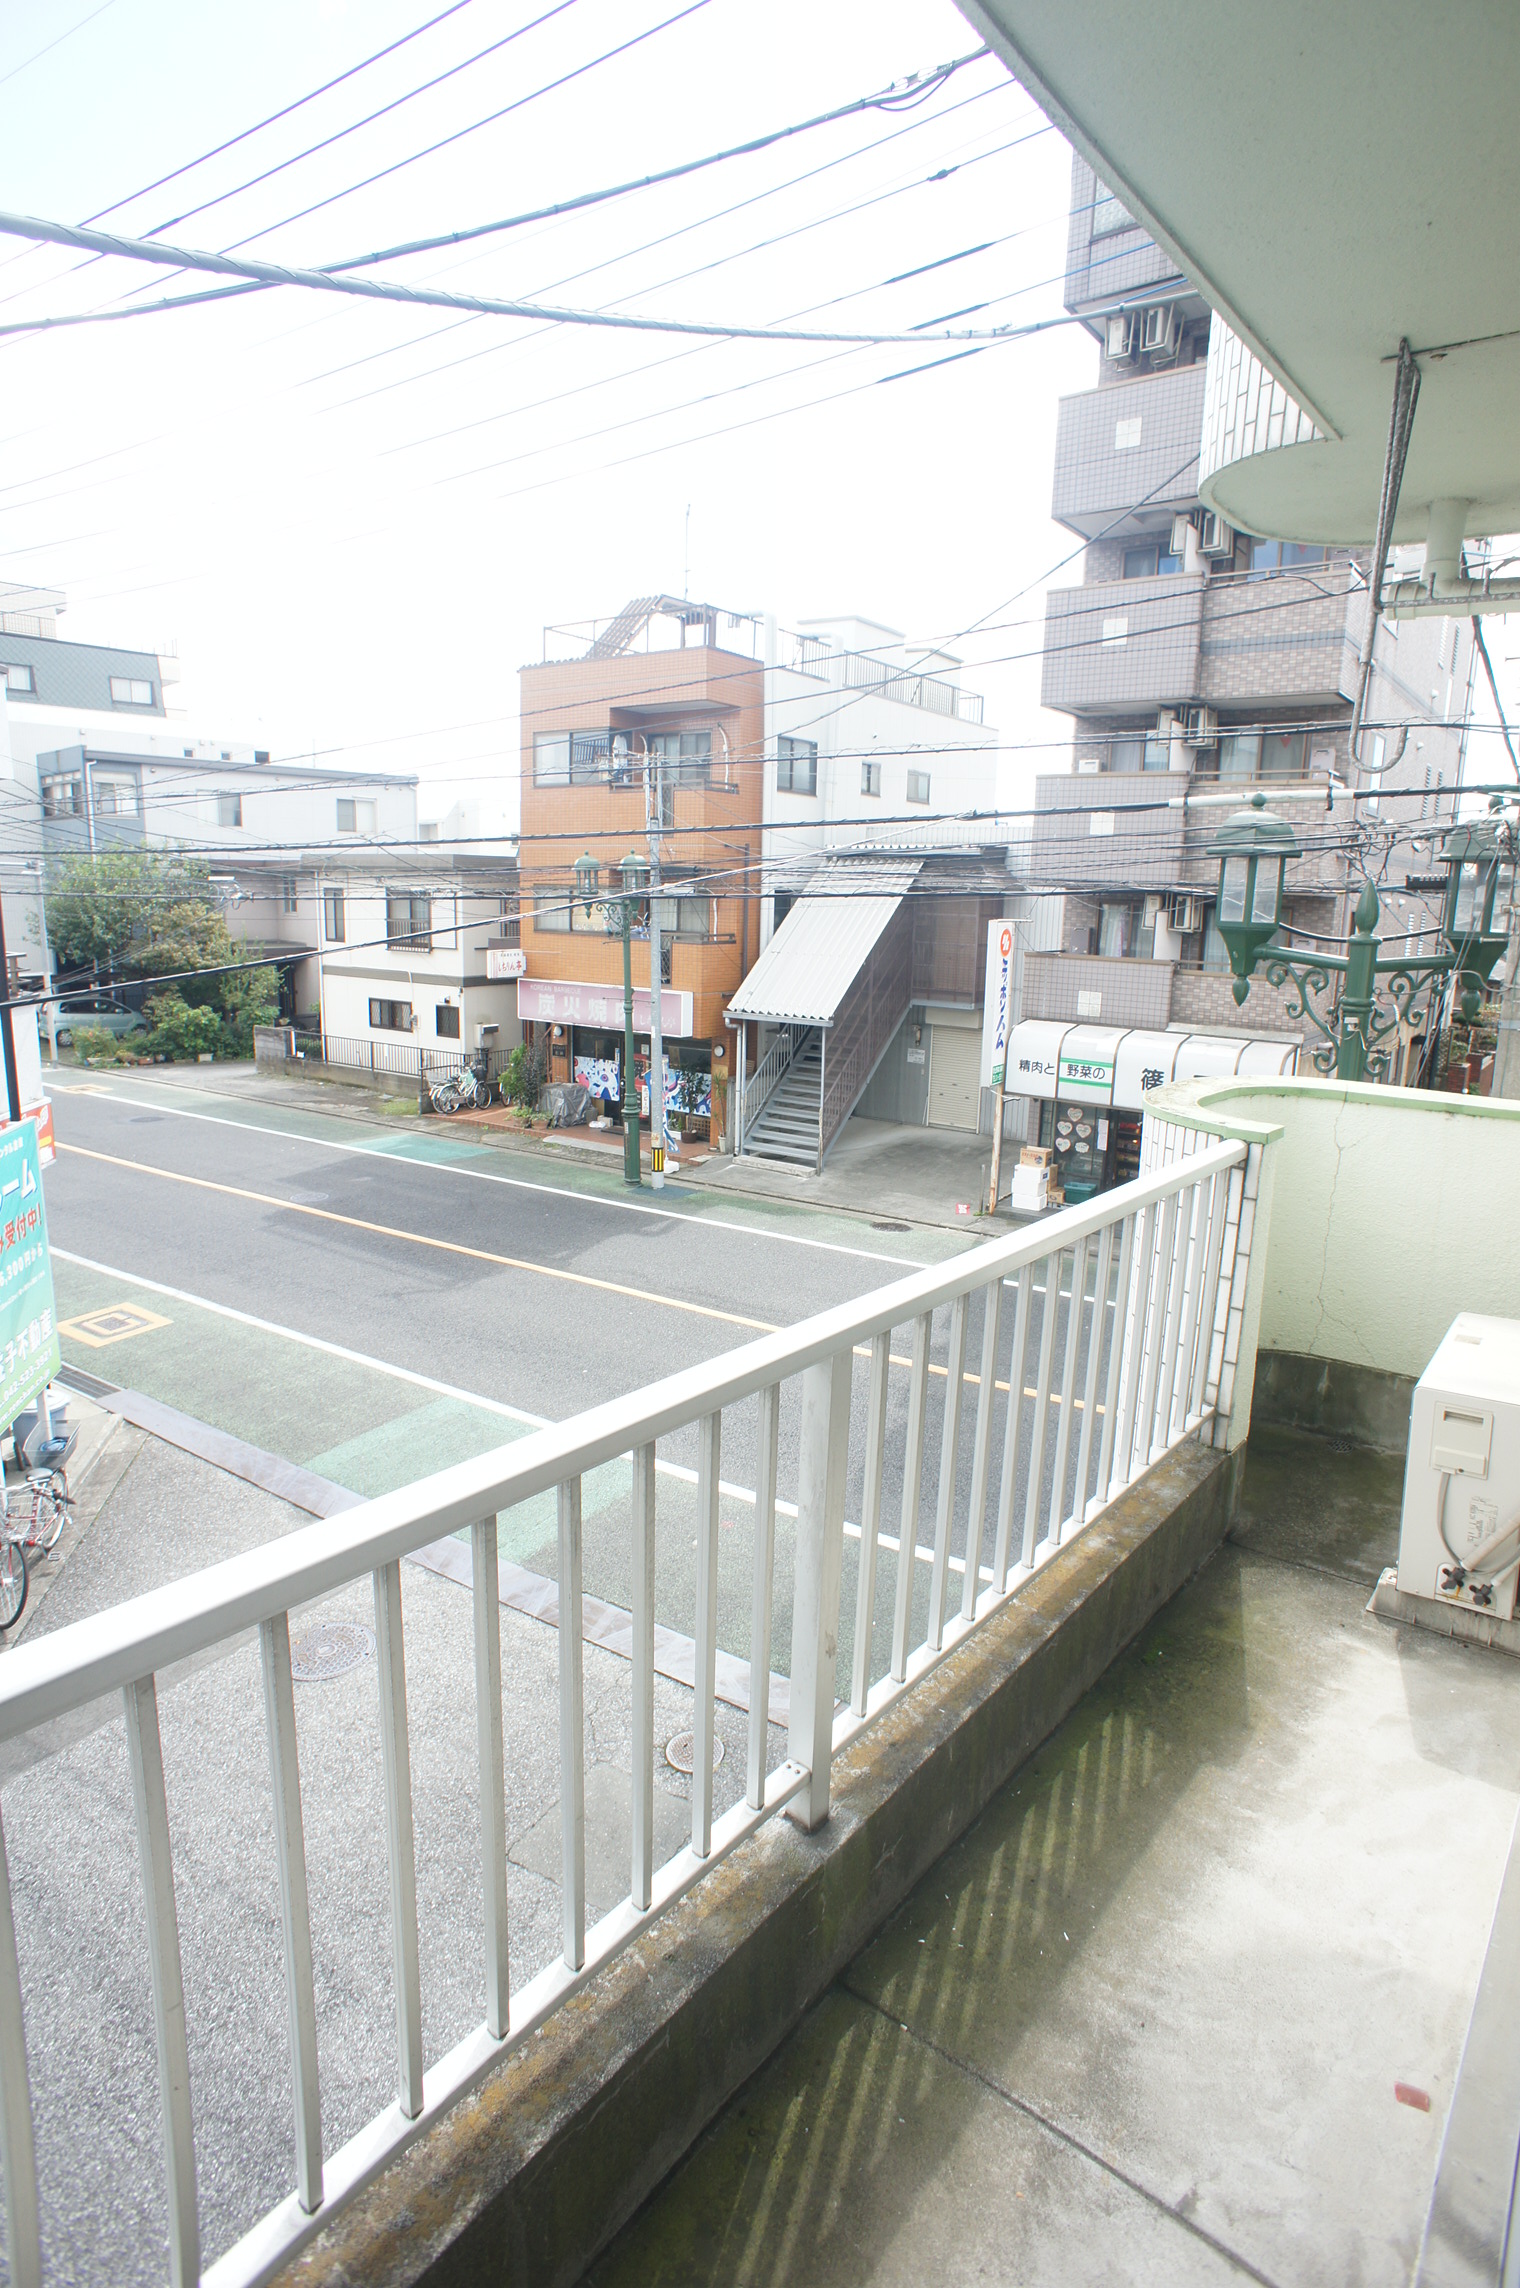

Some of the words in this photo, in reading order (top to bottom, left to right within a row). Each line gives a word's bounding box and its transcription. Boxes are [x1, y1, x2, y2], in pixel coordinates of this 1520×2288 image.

[1019, 1059, 1055, 1076] 精肉と
[1066, 1063, 1106, 1081] 野菜の
[0, 1157, 37, 1205] ーム
